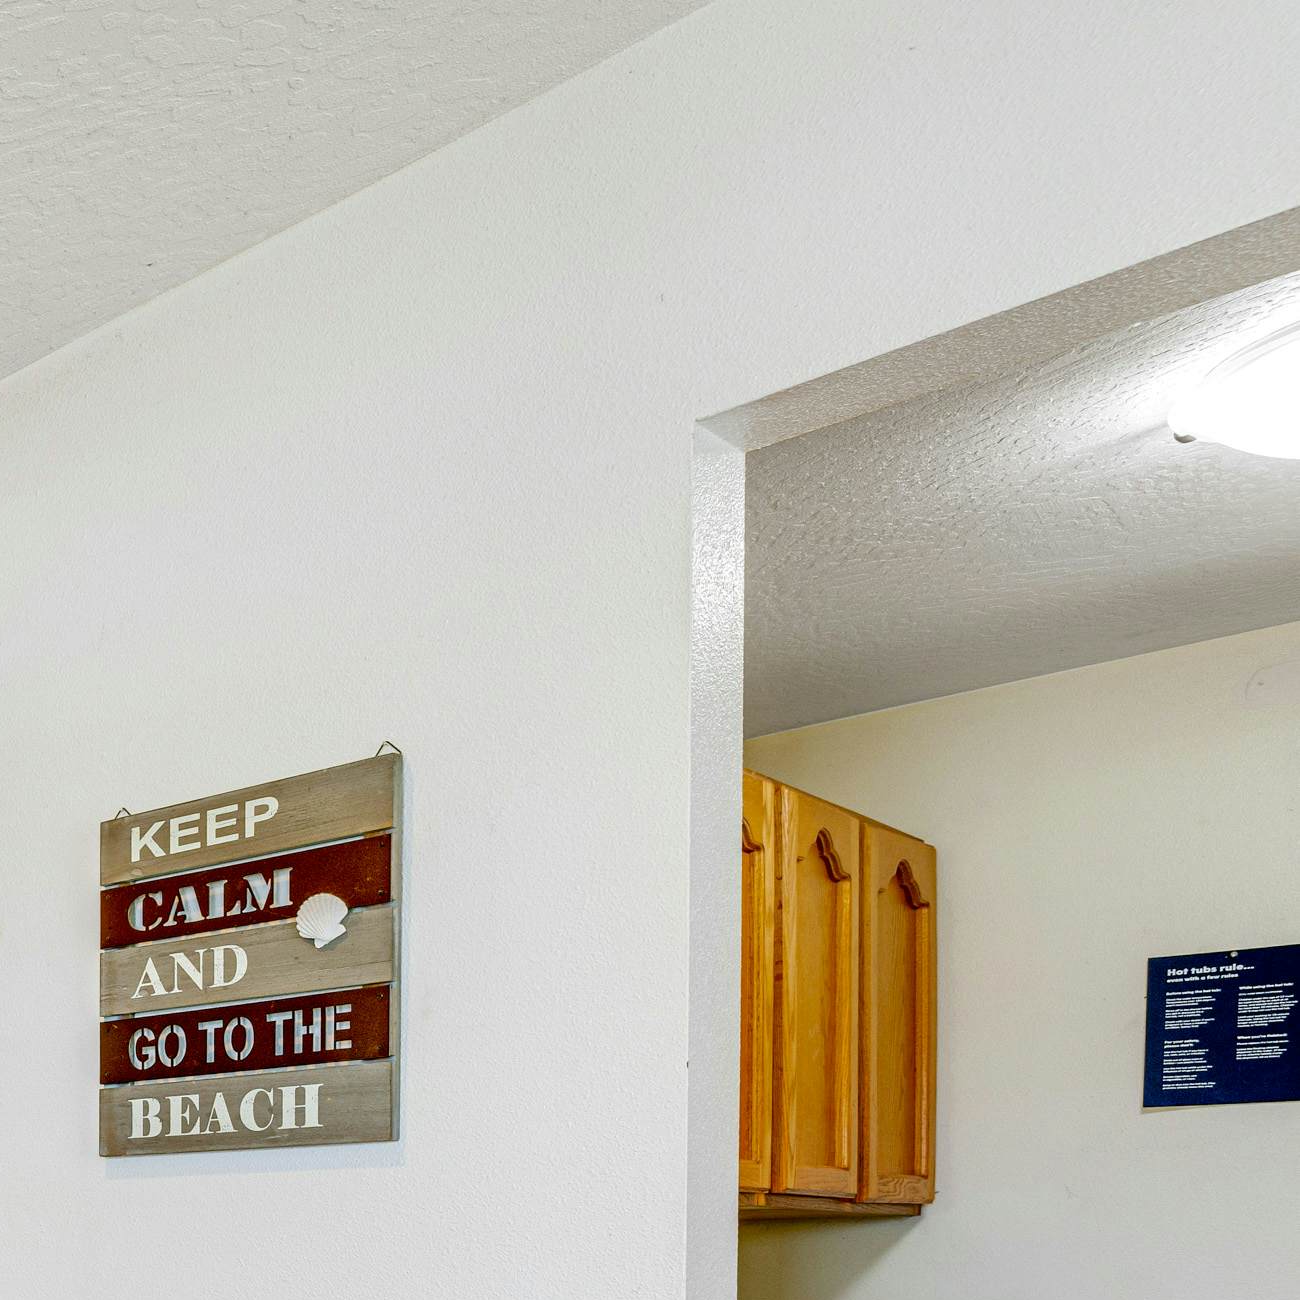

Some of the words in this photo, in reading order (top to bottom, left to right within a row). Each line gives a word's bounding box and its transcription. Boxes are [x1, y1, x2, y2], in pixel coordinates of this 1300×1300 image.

[131, 796, 279, 863] KEEP
[127, 866, 294, 932] CALM
[131, 944, 248, 999] AND
[1167, 968, 1188, 976] Hot
[1191, 966, 1217, 974] tubs
[128, 1024, 187, 1071] GO
[197, 1016, 255, 1063] TO
[266, 1003, 353, 1057] THE
[127, 1082, 324, 1140] BEACH
